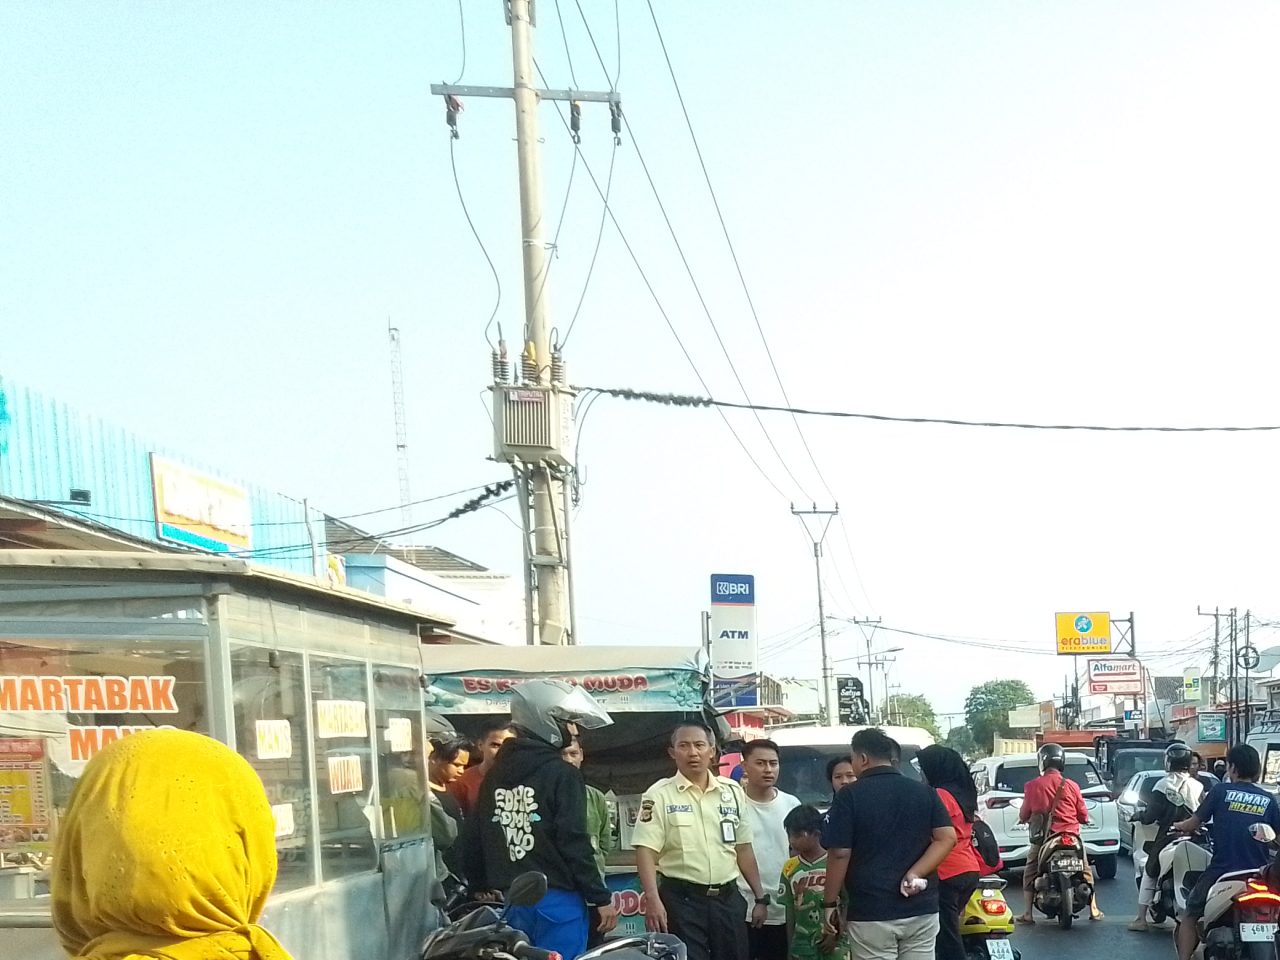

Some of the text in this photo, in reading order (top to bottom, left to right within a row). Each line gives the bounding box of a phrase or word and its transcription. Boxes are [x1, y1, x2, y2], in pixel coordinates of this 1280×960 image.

[729, 583, 749, 595] BRI
[719, 630, 749, 640] ATM
[1060, 635, 1107, 646] erablue
[1093, 662, 1136, 672] Alfamart
[463, 678, 489, 692] ES
[583, 675, 649, 692] MUDA
[0, 678, 175, 712] MARTABAK
[1225, 789, 1271, 810] DAMAR
[1229, 800, 1267, 817] HIZZAM
[1241, 924, 1247, 933] E
